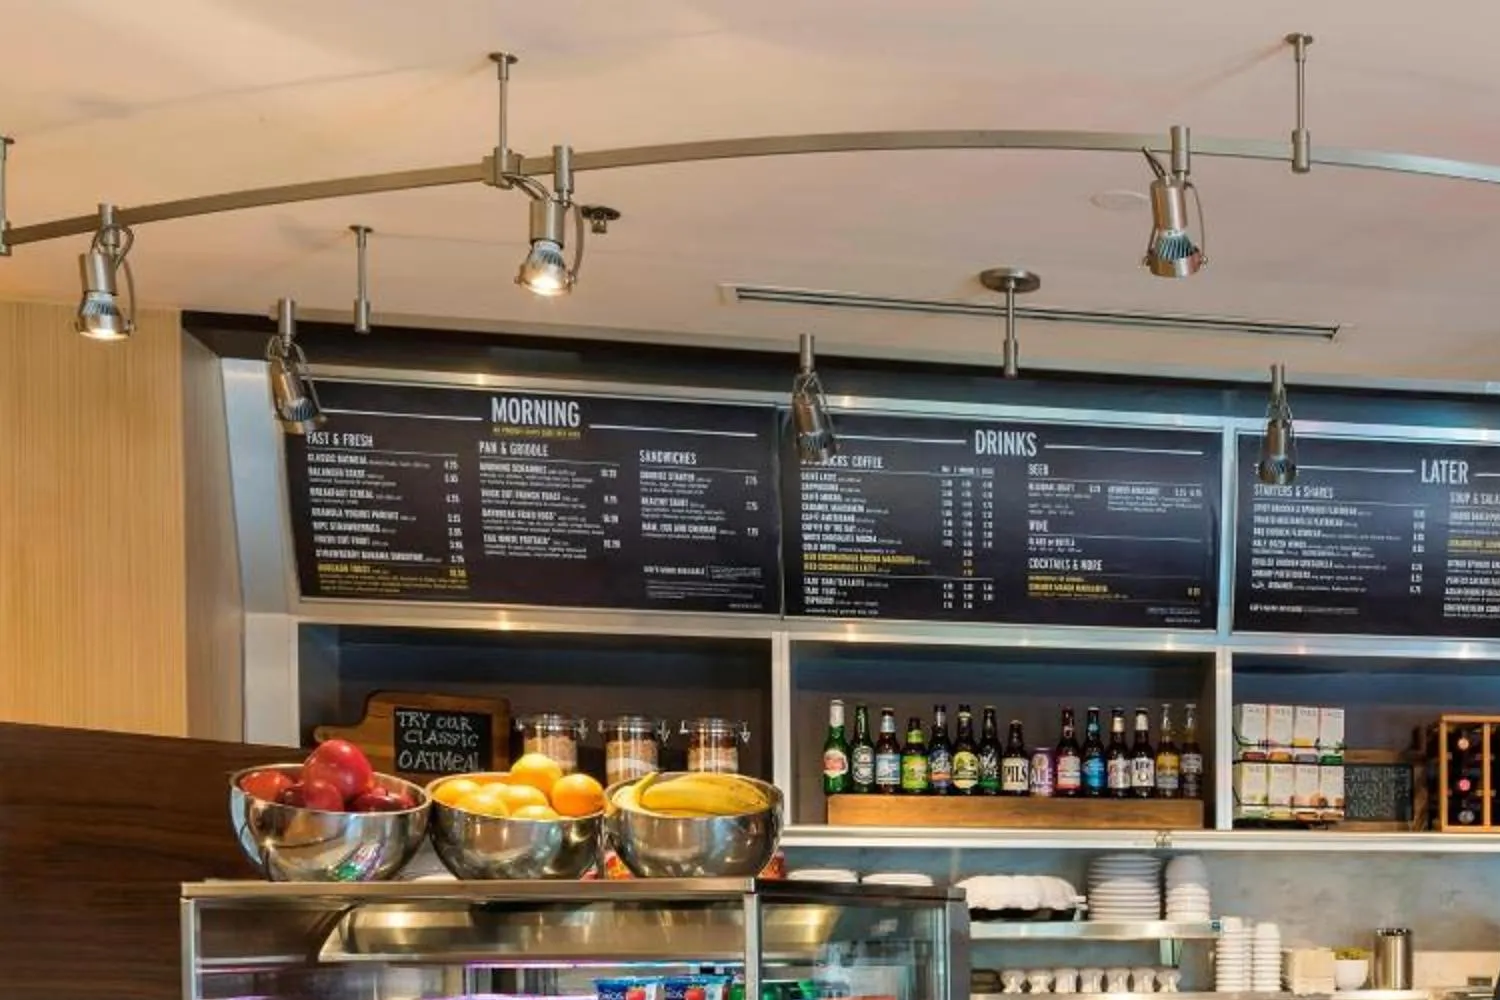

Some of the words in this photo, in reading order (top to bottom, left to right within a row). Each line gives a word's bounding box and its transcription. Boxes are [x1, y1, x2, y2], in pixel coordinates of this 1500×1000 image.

[491, 397, 581, 427] MORNING
[307, 432, 329, 445] FAST
[343, 433, 373, 448] FRESH
[975, 429, 1037, 457] DRINKS
[479, 441, 497, 455] PAN
[510, 443, 549, 457] GRIDDLE
[639, 450, 696, 465] SANDWICHES
[852, 455, 884, 468] COFFEE
[1028, 463, 1049, 476] BEER
[1421, 458, 1469, 484] LATER
[1253, 484, 1293, 497] STARTERS
[1028, 520, 1049, 533] WINE
[1028, 558, 1071, 570] COCKTAILS
[1081, 559, 1103, 571] MORE
[396, 711, 431, 729] TRY
[1003, 765, 1028, 783] PILS
[1030, 767, 1053, 785] ALE
